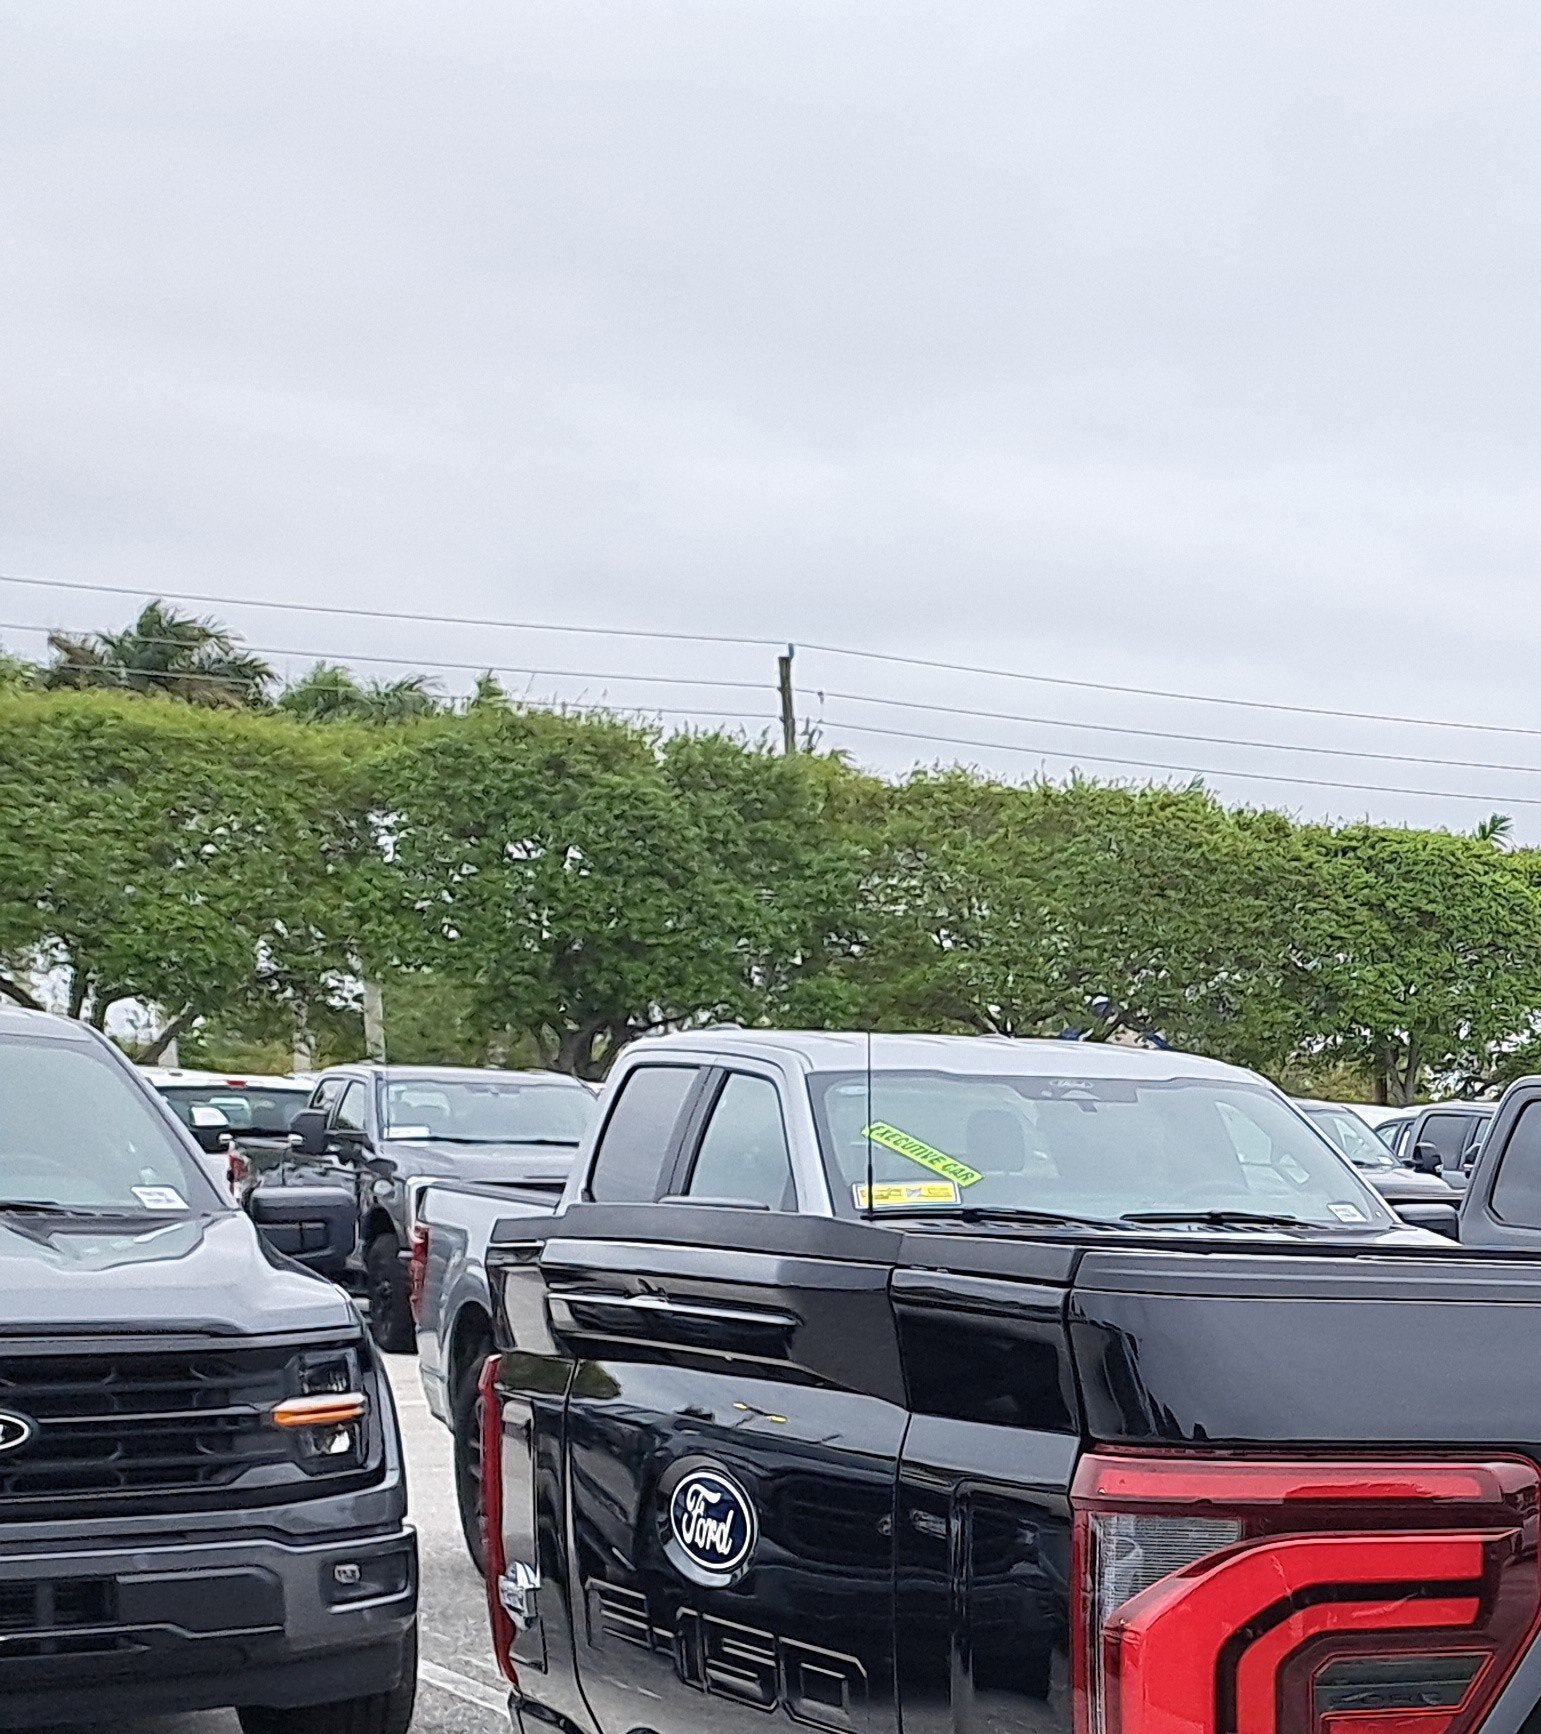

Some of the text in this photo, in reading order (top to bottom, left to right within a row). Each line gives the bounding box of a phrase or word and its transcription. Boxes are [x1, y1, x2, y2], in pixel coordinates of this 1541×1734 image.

[870, 1125, 976, 1182] EXECUTIVE CAR
[682, 1483, 735, 1556] Ford
